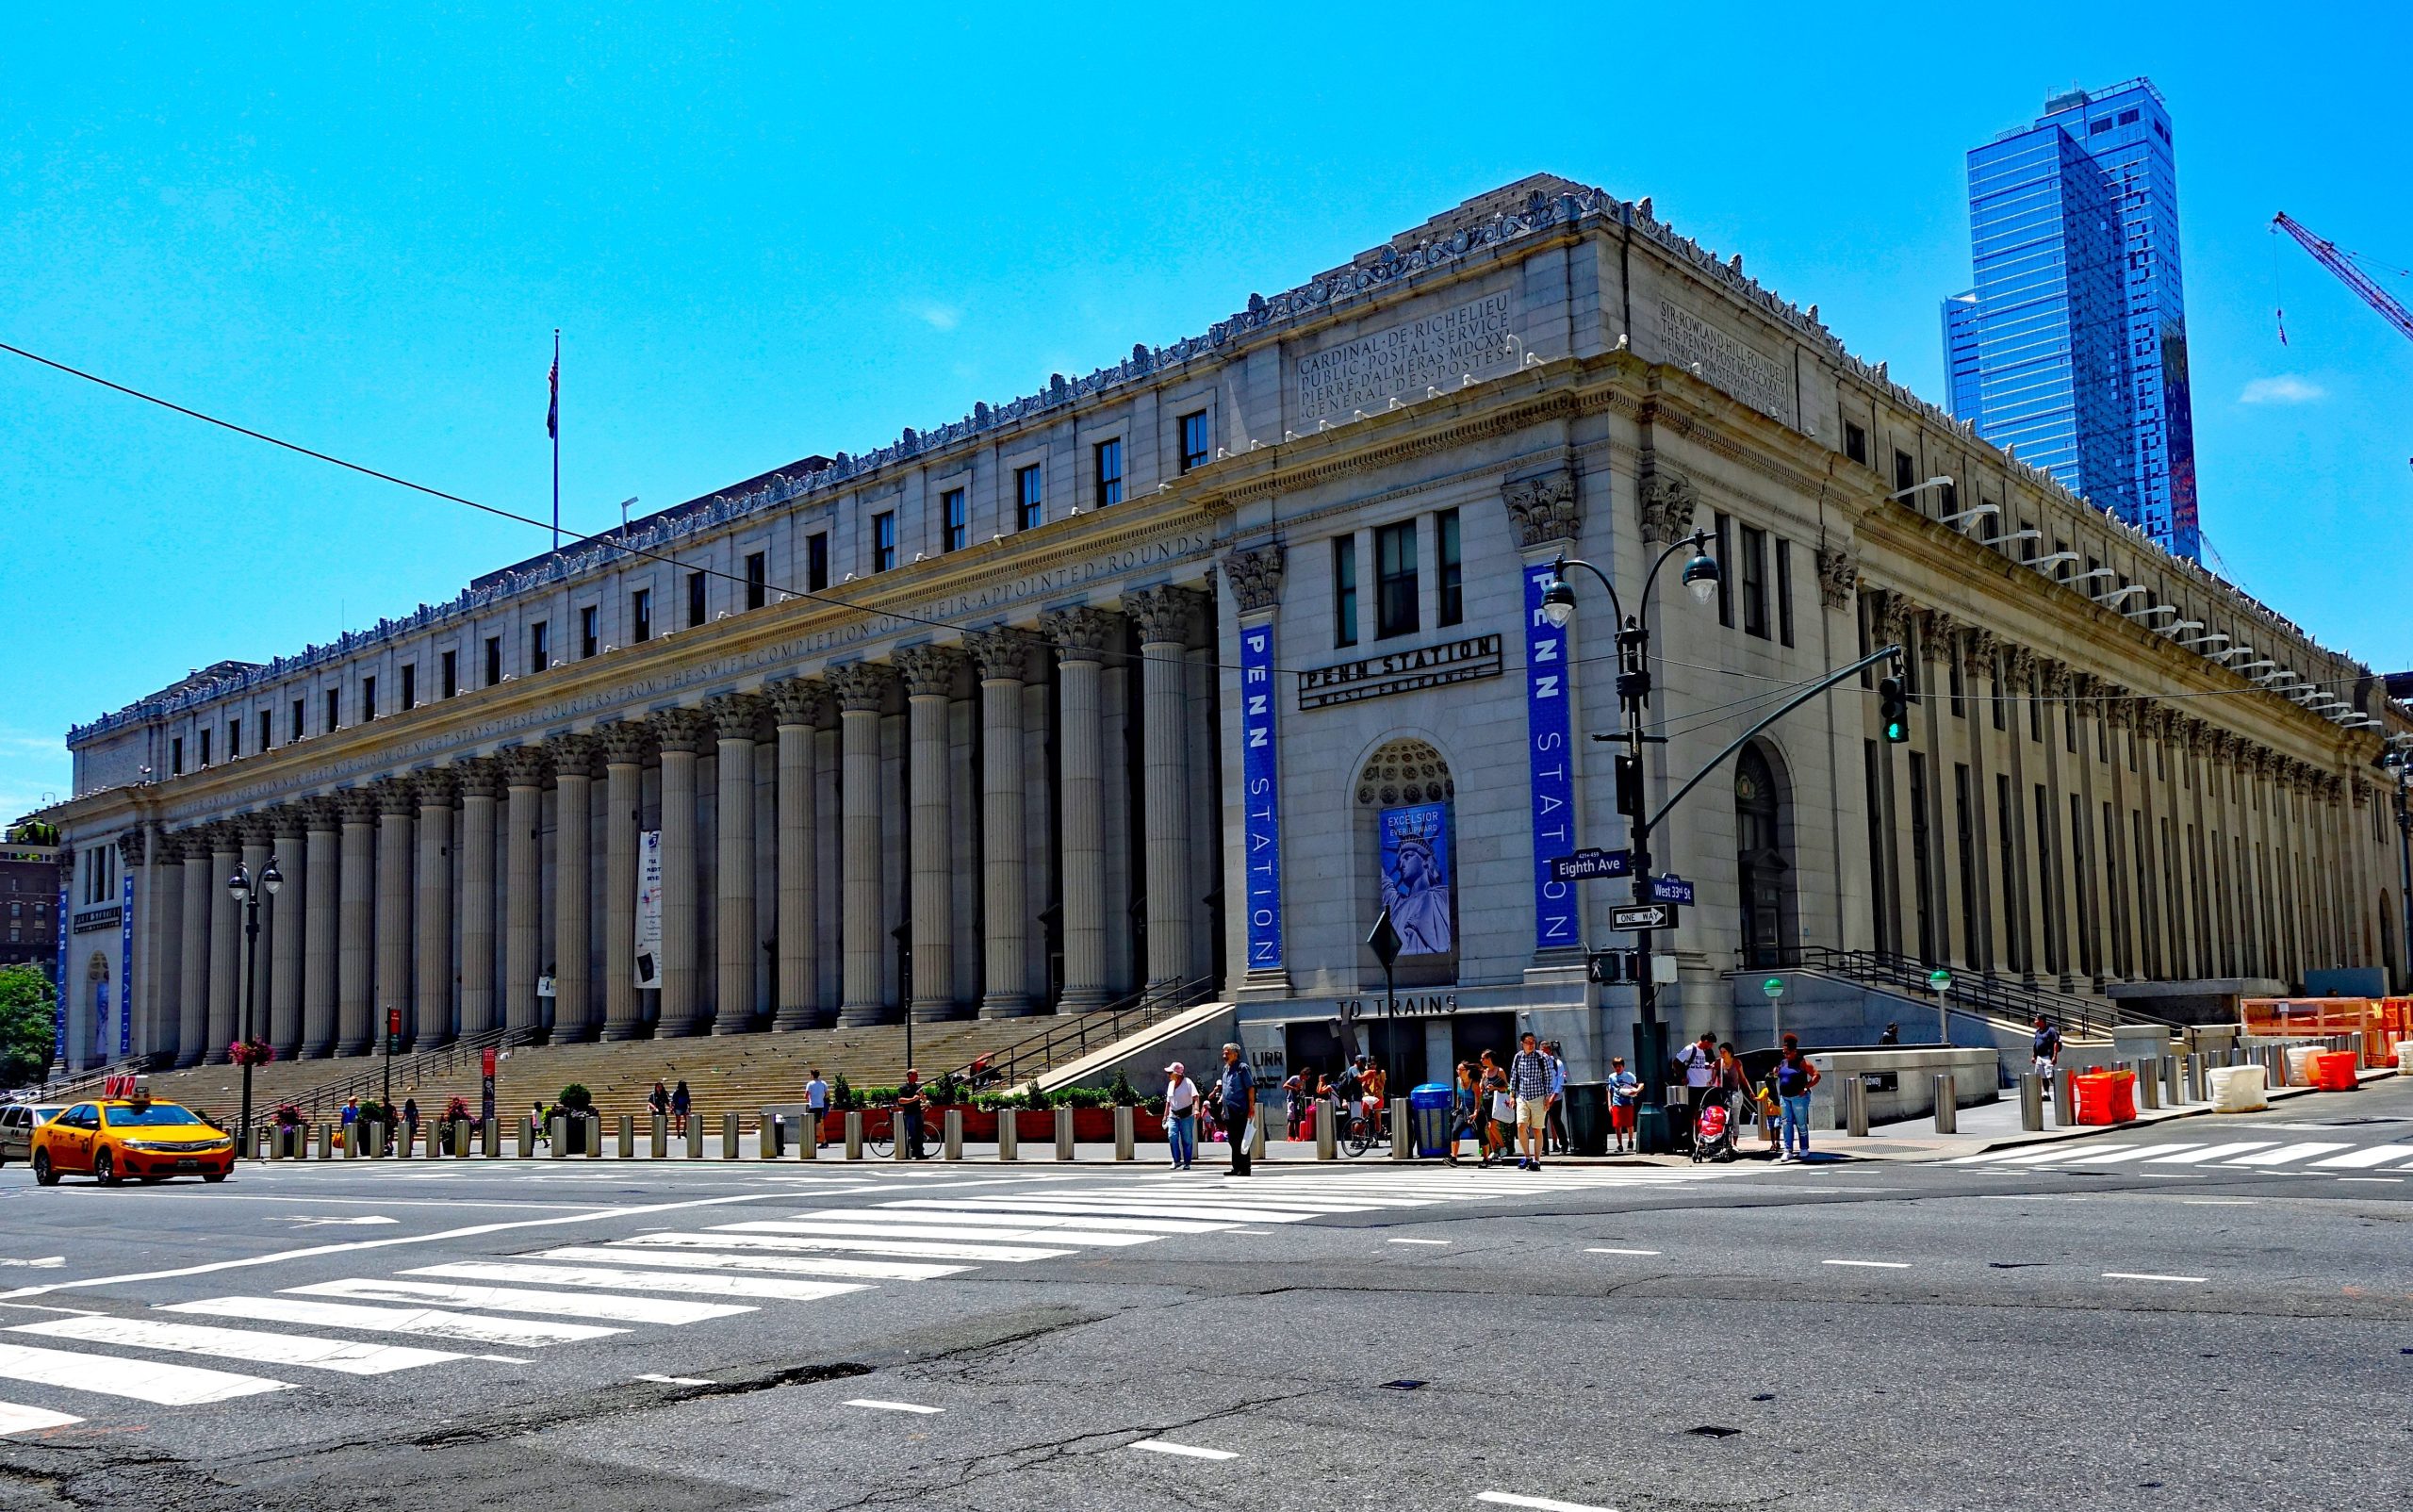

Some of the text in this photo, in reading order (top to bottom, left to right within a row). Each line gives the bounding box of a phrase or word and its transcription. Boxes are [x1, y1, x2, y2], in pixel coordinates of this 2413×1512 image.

[1300, 294, 1508, 375] CARDINAL DE RICHELIEU
[1302, 312, 1508, 391] PUBLIC POSTAL SERVICE
[1661, 301, 1785, 384] SIR ROWLAND HILL FOUNDED
[1662, 318, 1681, 340] THE
[1683, 329, 1715, 358] PENNY
[1715, 348, 1737, 370] POST
[1302, 377, 1354, 406] PIERRE
[1305, 347, 1505, 419] GENERAL DES POSTES
[1661, 334, 1787, 413] HEINRICH VON STEPHAN UNIVERSAL
[497, 712, 533, 732] THESE
[542, 689, 612, 721] COURIERS
[618, 680, 656, 701] FROM
[665, 668, 692, 689] THE
[700, 654, 749, 678] SWIFT
[756, 622, 870, 666] COMPLETION
[910, 596, 970, 624] THEIR
[978, 562, 1095, 608] APPOINTED
[1108, 531, 1205, 574] ROUNDS
[1307, 637, 1490, 688] PENN STATION
[1319, 687, 1365, 706] WEST
[1247, 634, 1272, 961] PENN STATION
[1387, 811, 1438, 827] EXCELSIOR
[1559, 858, 1620, 878] Eighth Ave
[1654, 883, 1691, 900] West 33rd St
[1620, 912, 1659, 923] ONE WAY
[1337, 994, 1458, 1019] TO TRAINS
[1252, 1051, 1283, 1067] LIRR
[1863, 1076, 1881, 1087] ubway
